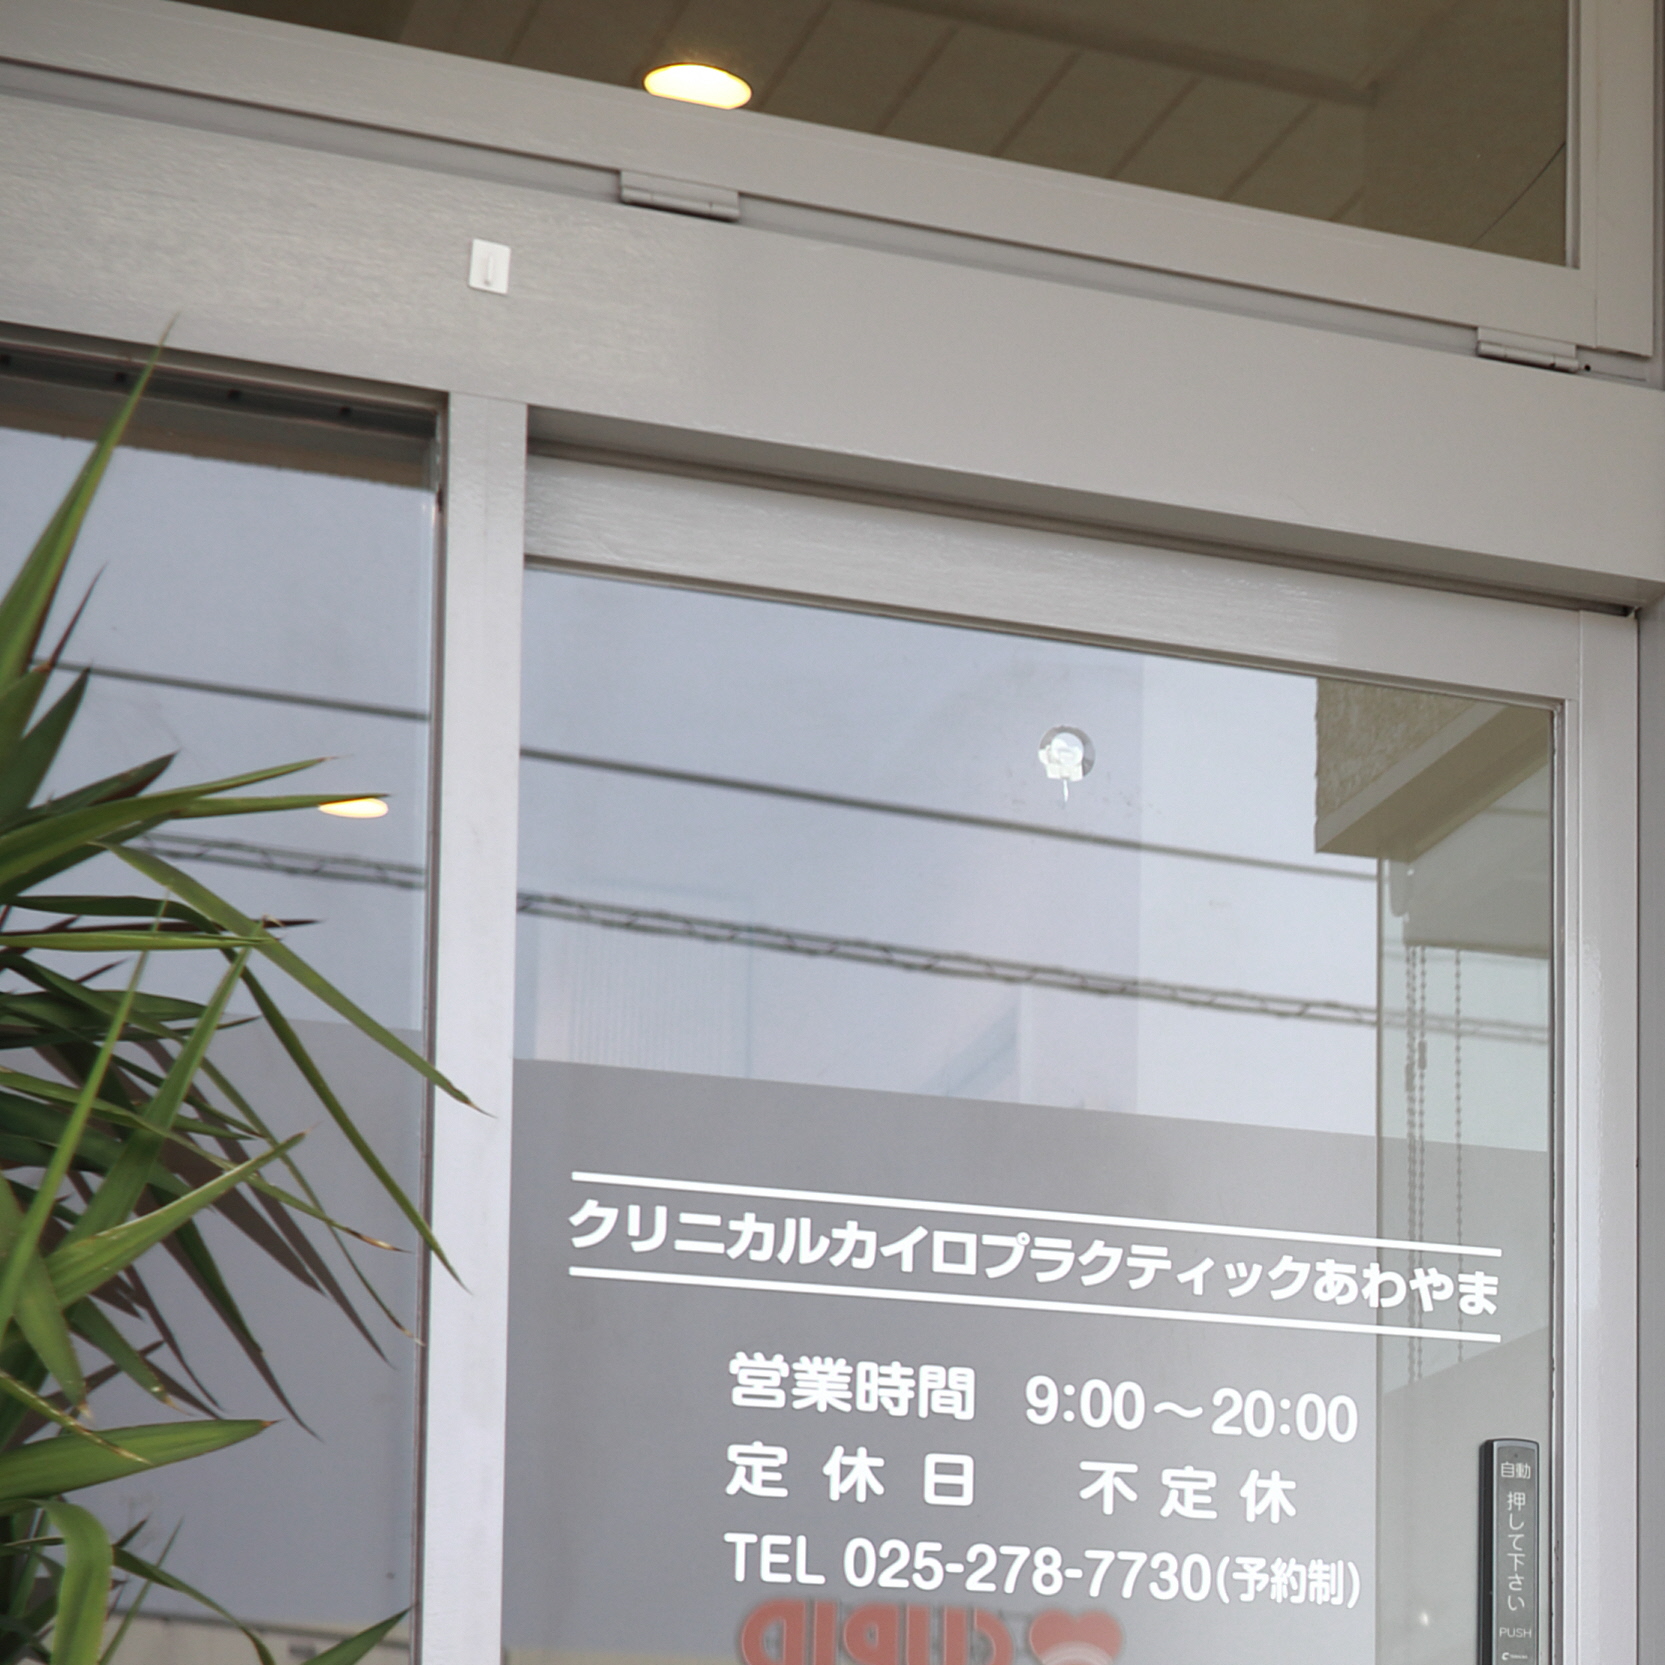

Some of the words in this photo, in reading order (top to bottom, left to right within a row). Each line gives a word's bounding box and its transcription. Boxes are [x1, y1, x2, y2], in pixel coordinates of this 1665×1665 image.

[567, 1197, 1500, 1317] クリニカルカイロプラクティックあわやま
[727, 1350, 977, 1424] 営業時間
[1078, 1460, 1298, 1524] 不定休
[1500, 1461, 1531, 1480] 自動
[724, 1532, 827, 1587] TEL
[843, 1535, 1361, 1609] 025-278-7730(予約制)
[1506, 1491, 1526, 1612] 押して下さい
[1499, 1626, 1532, 1639] PUSH
